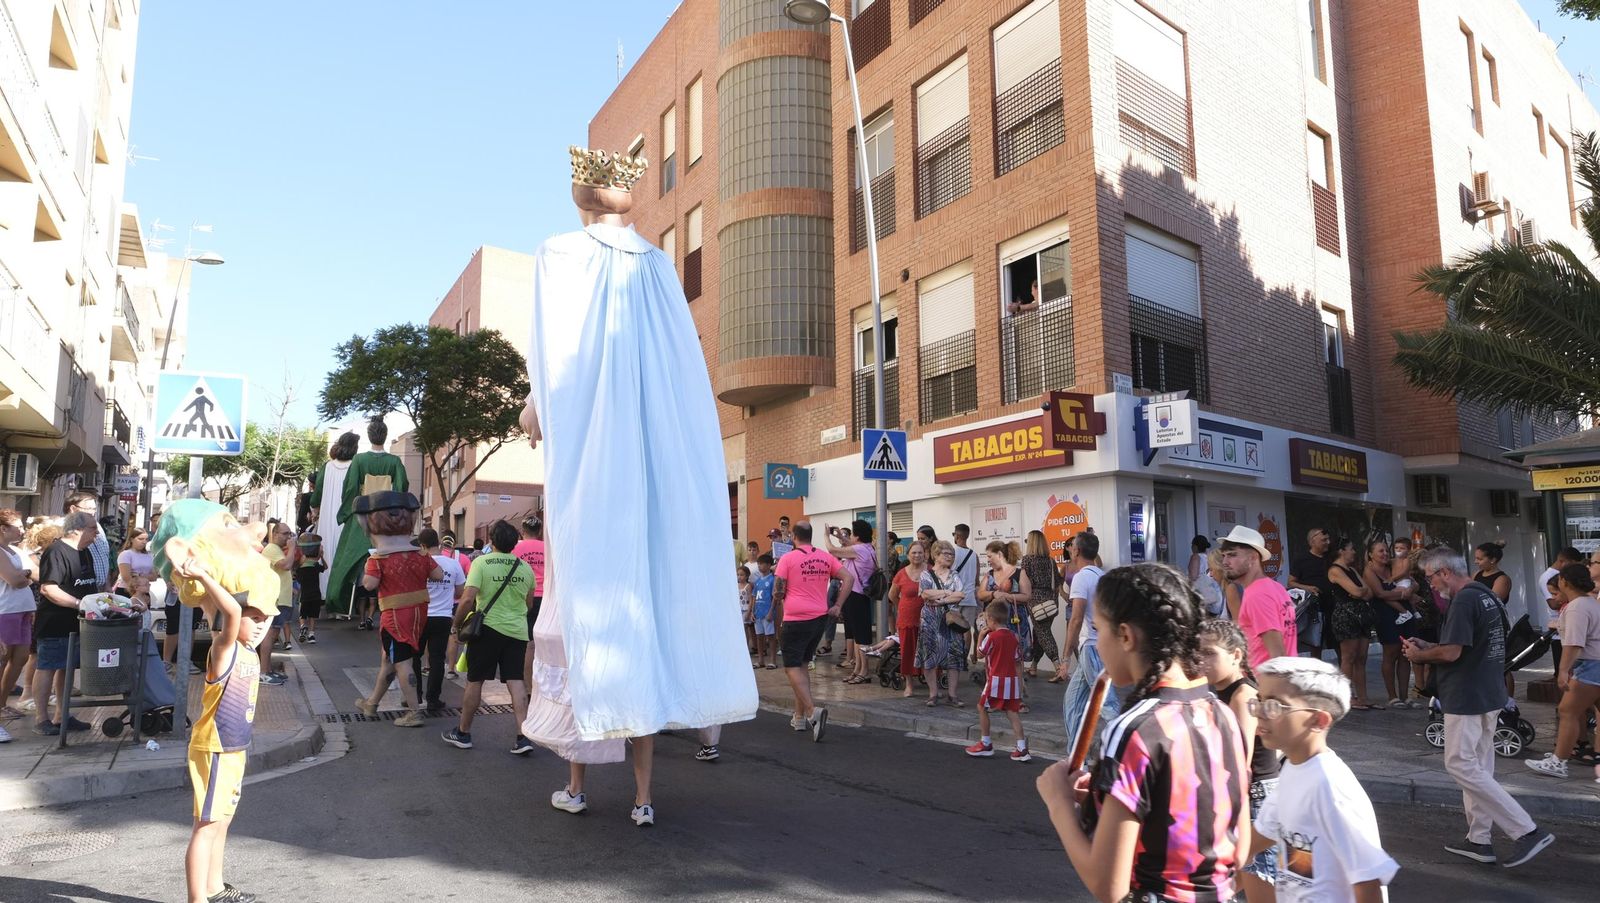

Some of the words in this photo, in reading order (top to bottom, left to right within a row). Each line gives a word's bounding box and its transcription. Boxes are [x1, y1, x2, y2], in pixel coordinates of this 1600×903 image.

[950, 425, 1044, 463] TABACOS
[1055, 434, 1094, 444] TABACOS
[1308, 448, 1358, 476] TABACOS
[1061, 528, 1071, 536] TU
[1050, 541, 1065, 551] CHE
[520, 551, 544, 560] Charan
[801, 568, 829, 576] Nebulos
